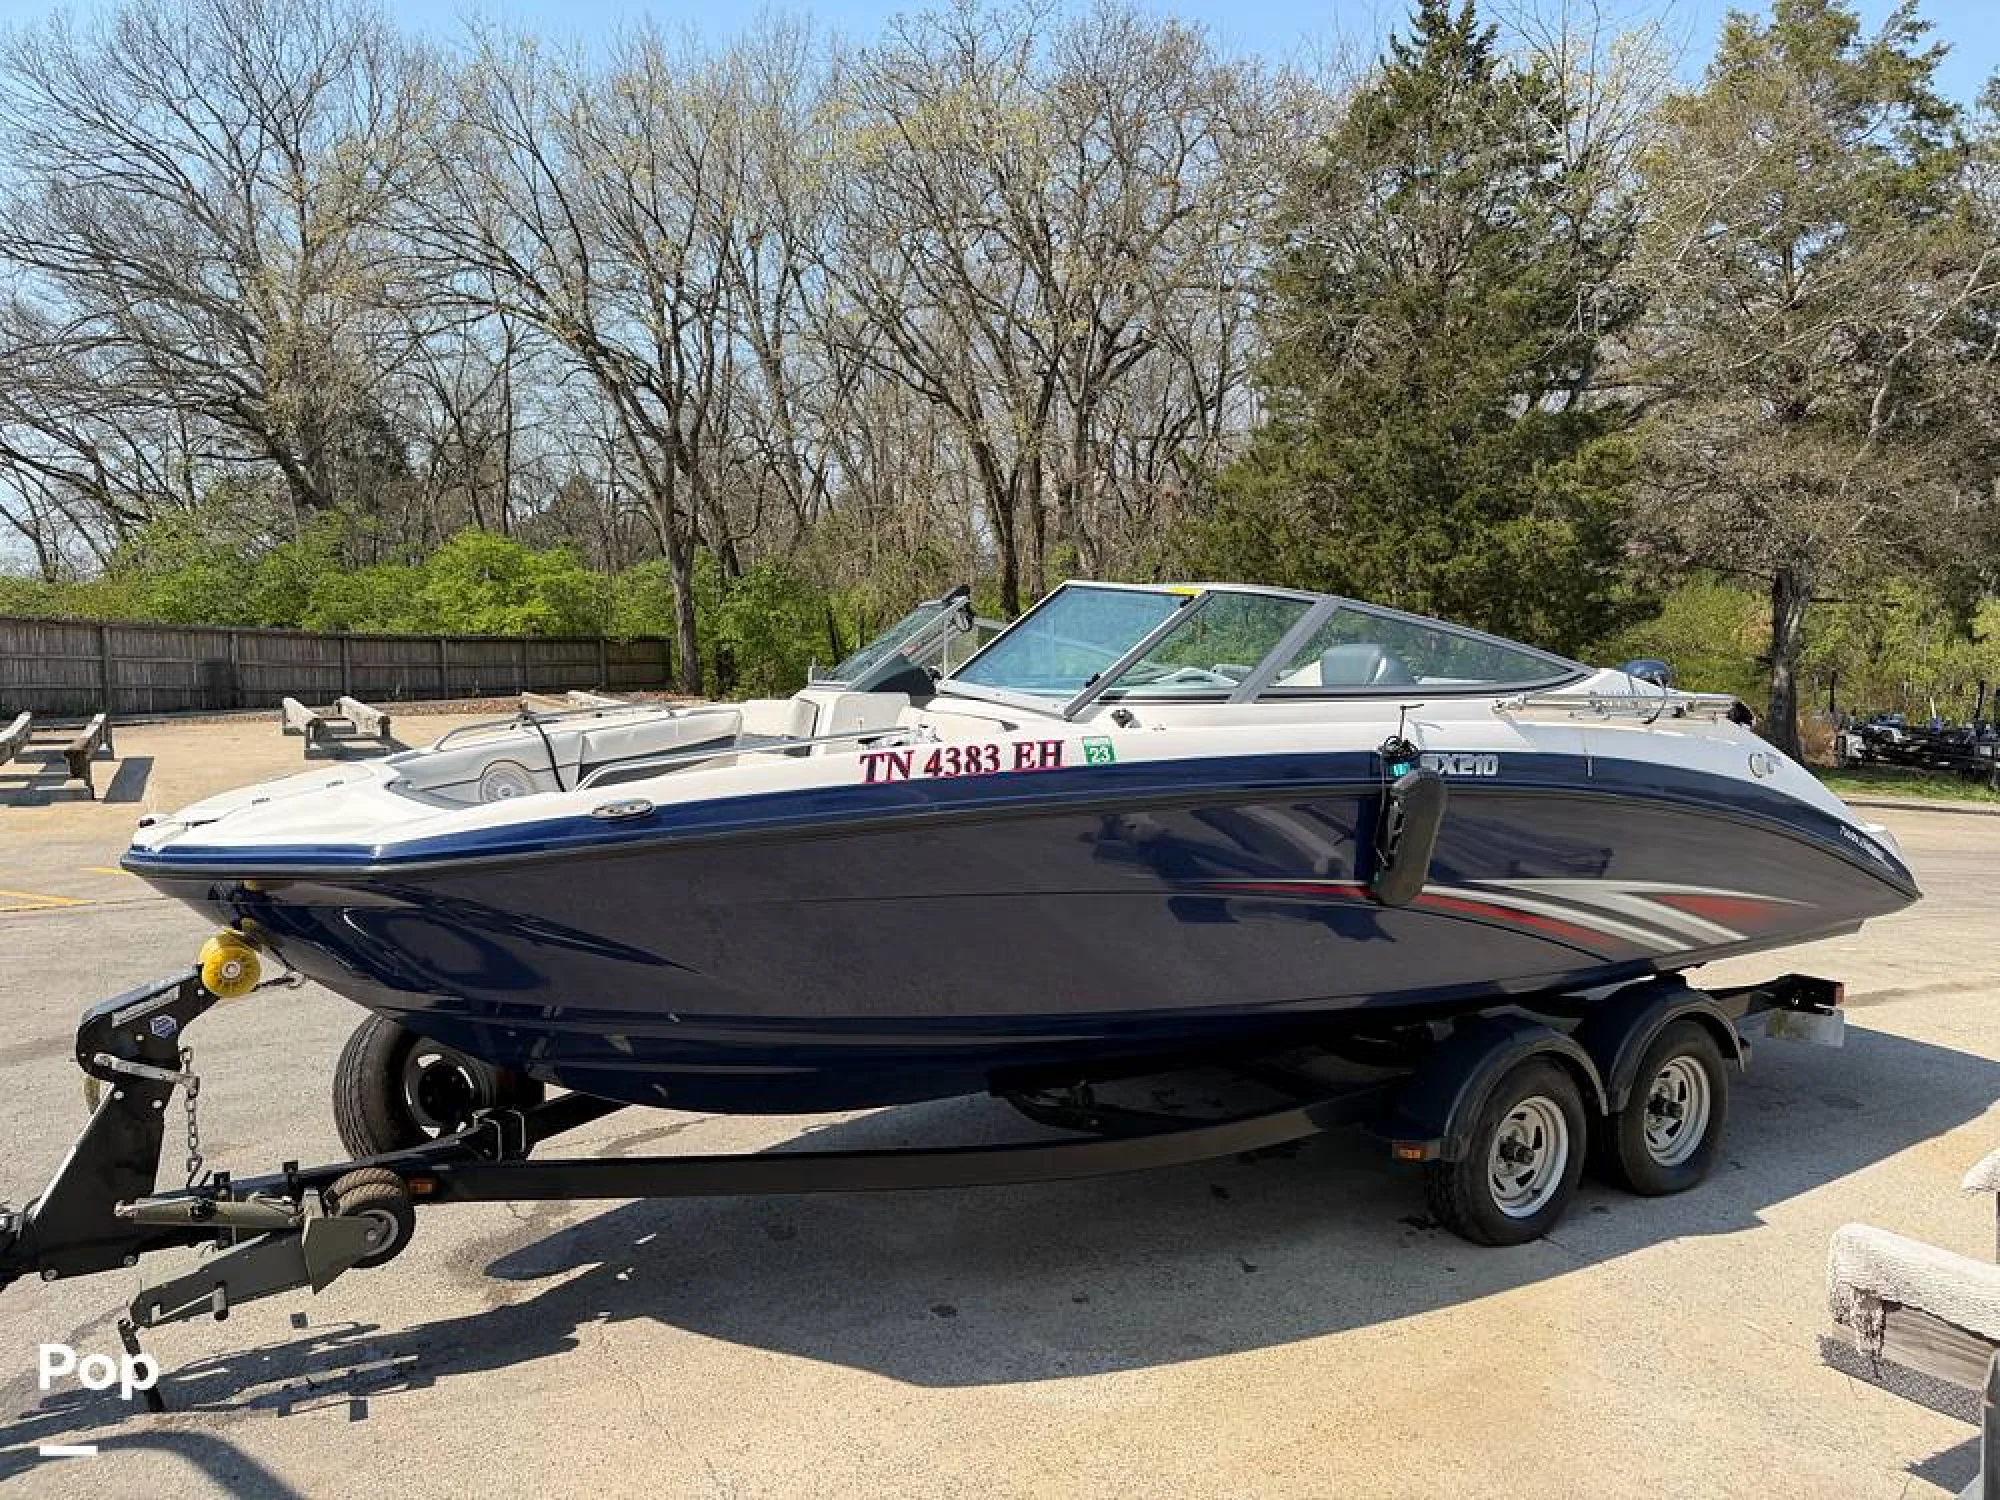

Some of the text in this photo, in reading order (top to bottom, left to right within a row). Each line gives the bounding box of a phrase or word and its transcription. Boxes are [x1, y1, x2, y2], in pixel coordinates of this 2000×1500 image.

[859, 740, 1064, 783] TN 4383 EH
[1089, 747, 1111, 763] 23
